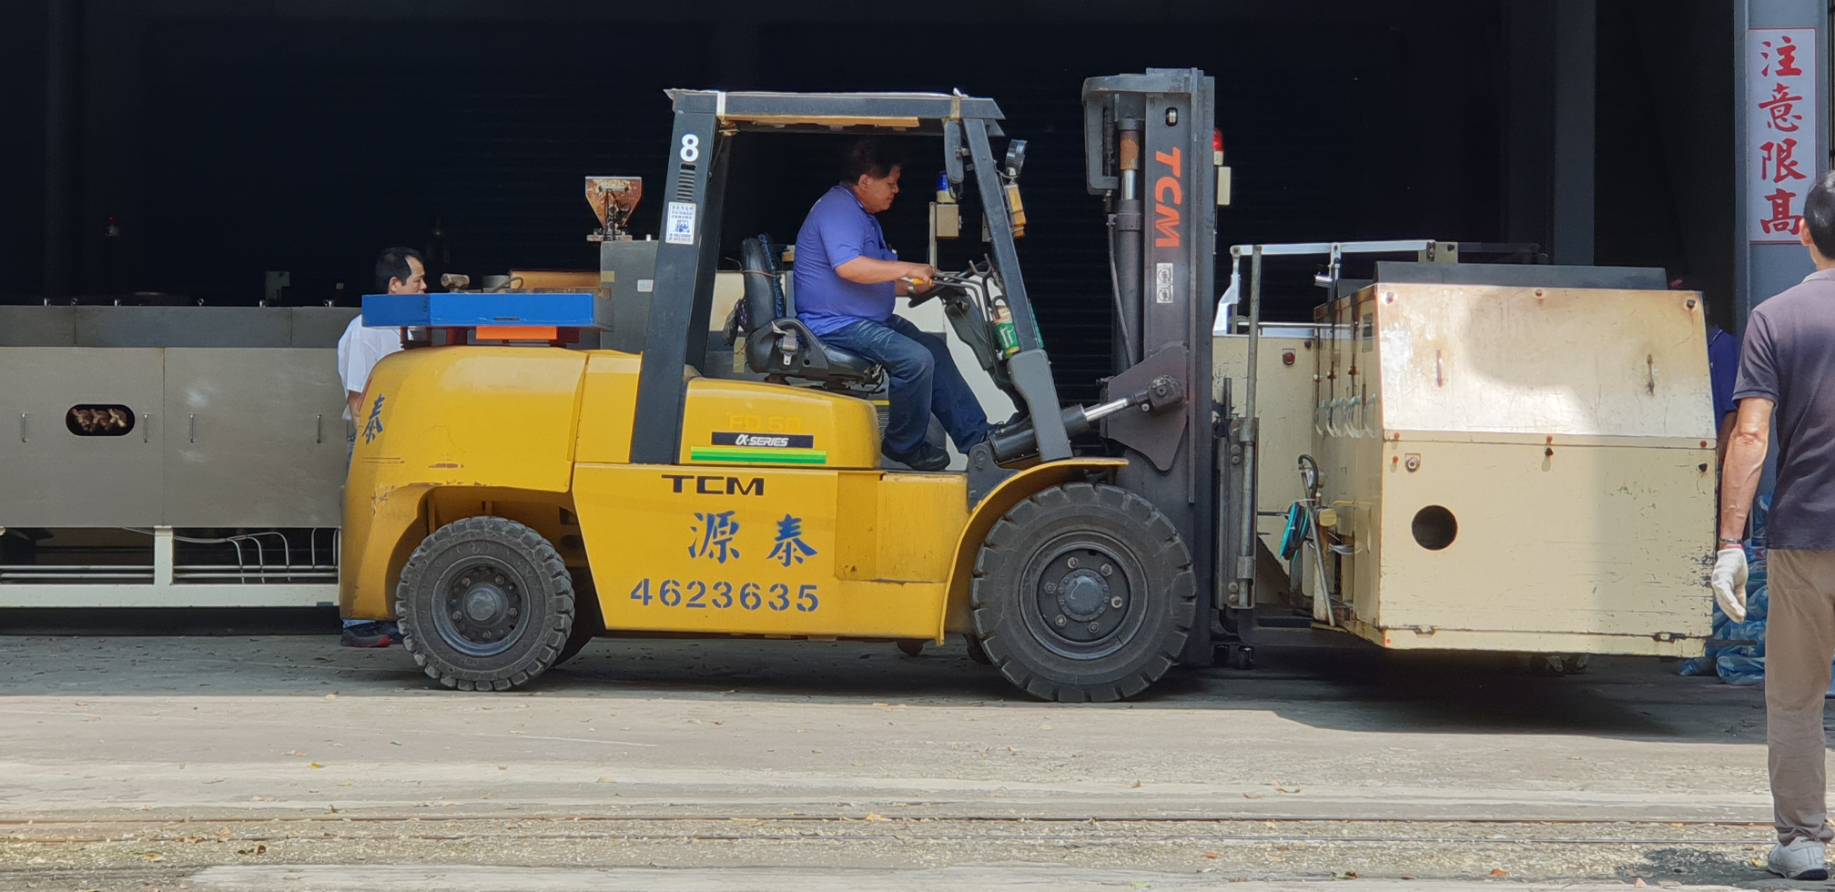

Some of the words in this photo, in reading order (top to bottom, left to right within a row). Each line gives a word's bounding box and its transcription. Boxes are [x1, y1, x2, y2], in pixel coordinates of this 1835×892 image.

[680, 133, 699, 162] 8
[1759, 35, 1808, 236] 注意限高
[1154, 147, 1184, 248] TCM
[661, 474, 765, 496] TCM
[630, 577, 819, 613] 4623635
